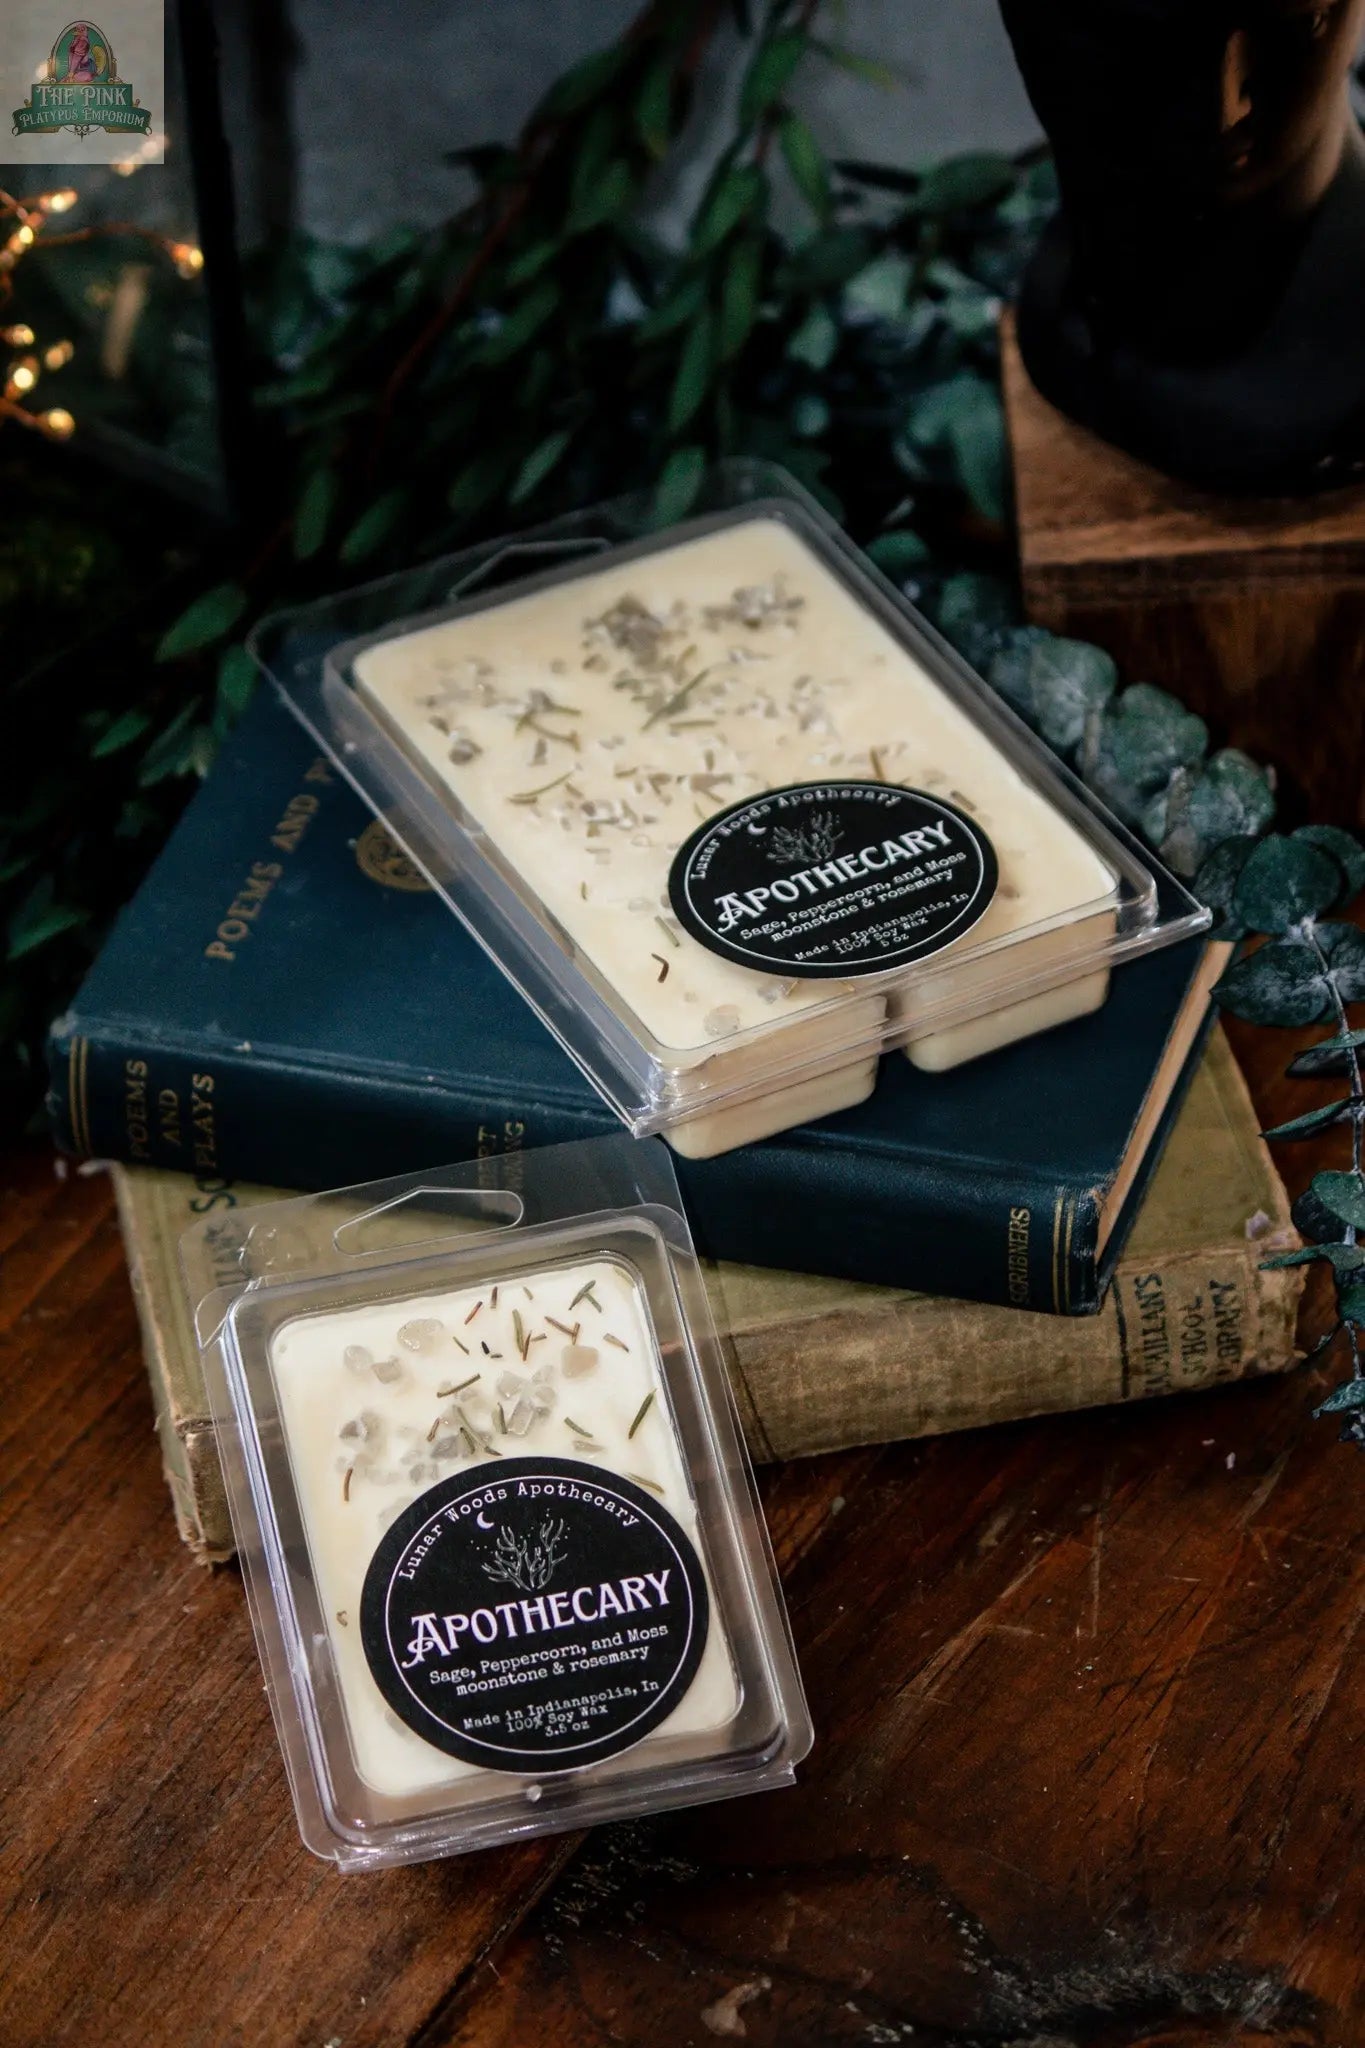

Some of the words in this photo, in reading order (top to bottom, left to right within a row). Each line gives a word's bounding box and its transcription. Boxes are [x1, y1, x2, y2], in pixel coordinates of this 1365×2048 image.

[690, 838, 720, 880] Lunar
[717, 804, 771, 836] Woods
[777, 788, 902, 808] Apothecary
[205, 861, 283, 961] POEMS
[269, 794, 319, 853] AND
[713, 820, 954, 932] APOTHECARY
[740, 919, 787, 941] Sage,
[787, 881, 892, 923] Peppercorn,
[892, 866, 925, 885] and
[925, 851, 968, 873] Moss
[770, 903, 860, 943] moonstone
[861, 897, 876, 909] &
[877, 868, 954, 903] rosemary
[794, 943, 830, 962] Made
[832, 936, 850, 948] in
[850, 900, 951, 940] Indianapolis,
[951, 892, 970, 904] In
[838, 936, 871, 955] 100%
[872, 926, 899, 941] Soy
[902, 917, 929, 930] Wax
[893, 933, 910, 943] oz
[125, 1059, 151, 1158] POEMS
[159, 1088, 181, 1147] AND
[191, 1072, 217, 1169] PLAYS
[398, 1525, 443, 1581] Lunar
[444, 1486, 508, 1524] Woods
[517, 1481, 640, 1529] Apothecary
[401, 1569, 672, 1669] APOTHECARY
[429, 1664, 477, 1685] Sage,
[480, 1642, 588, 1676] Peppercorn,
[591, 1631, 624, 1651] and
[627, 1624, 669, 1644] Moss
[456, 1666, 549, 1696] moonstone
[552, 1662, 566, 1675] &
[570, 1645, 650, 1673] rosemary
[463, 1714, 501, 1730] Made
[505, 1710, 523, 1722] in
[527, 1688, 638, 1717] Indianapolis,
[640, 1680, 660, 1693] In
[506, 1714, 543, 1734] 100%
[547, 1711, 575, 1725] Soy
[581, 1704, 609, 1716] Wax
[544, 1723, 568, 1738] 3.5
[572, 1720, 591, 1732] oz
